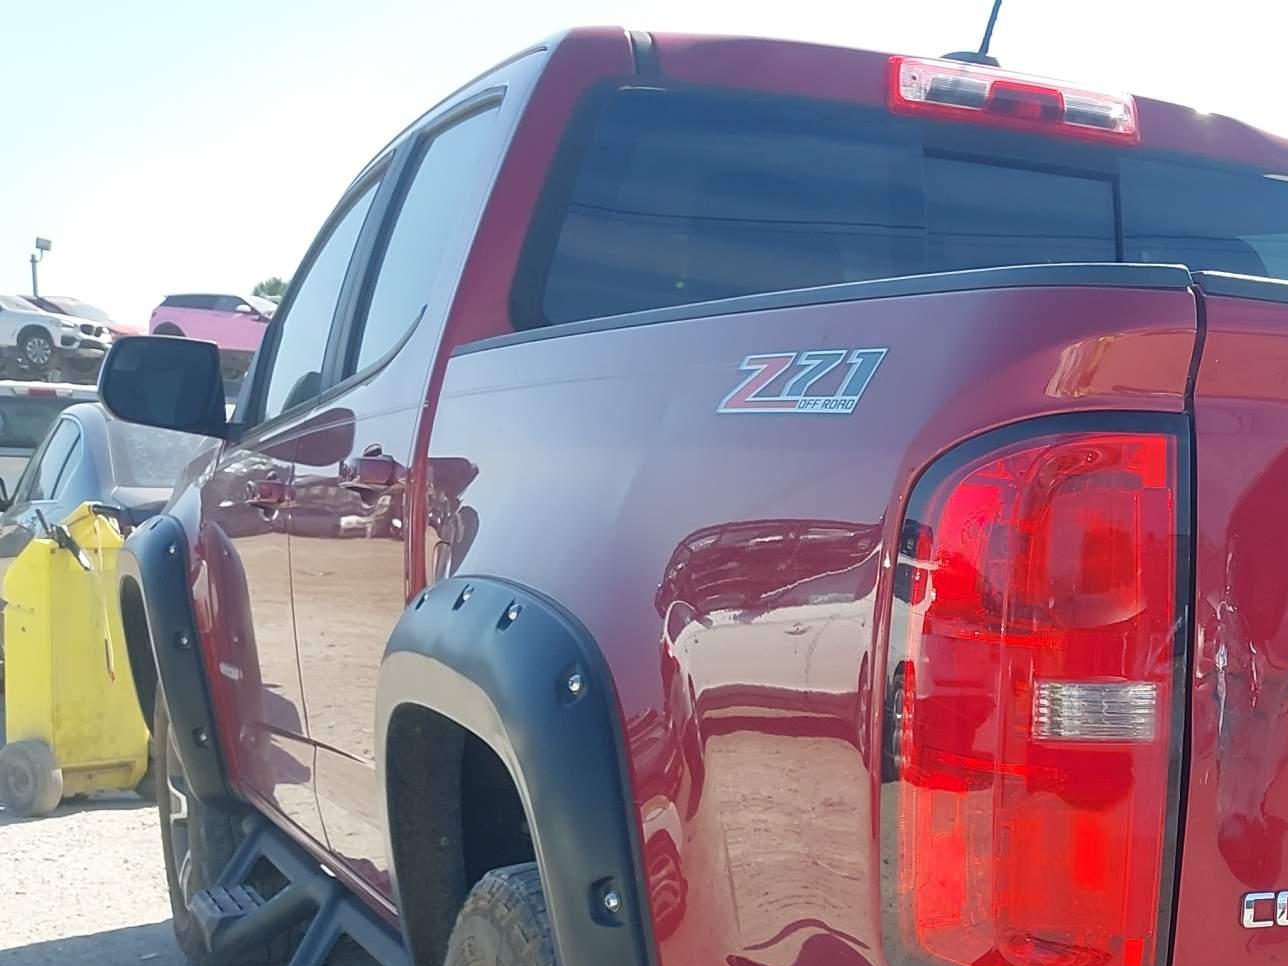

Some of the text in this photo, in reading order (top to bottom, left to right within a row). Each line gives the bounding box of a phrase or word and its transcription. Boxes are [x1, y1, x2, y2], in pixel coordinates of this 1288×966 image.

[716, 348, 889, 414] Z71
[799, 400, 855, 409] OFF ROAD
